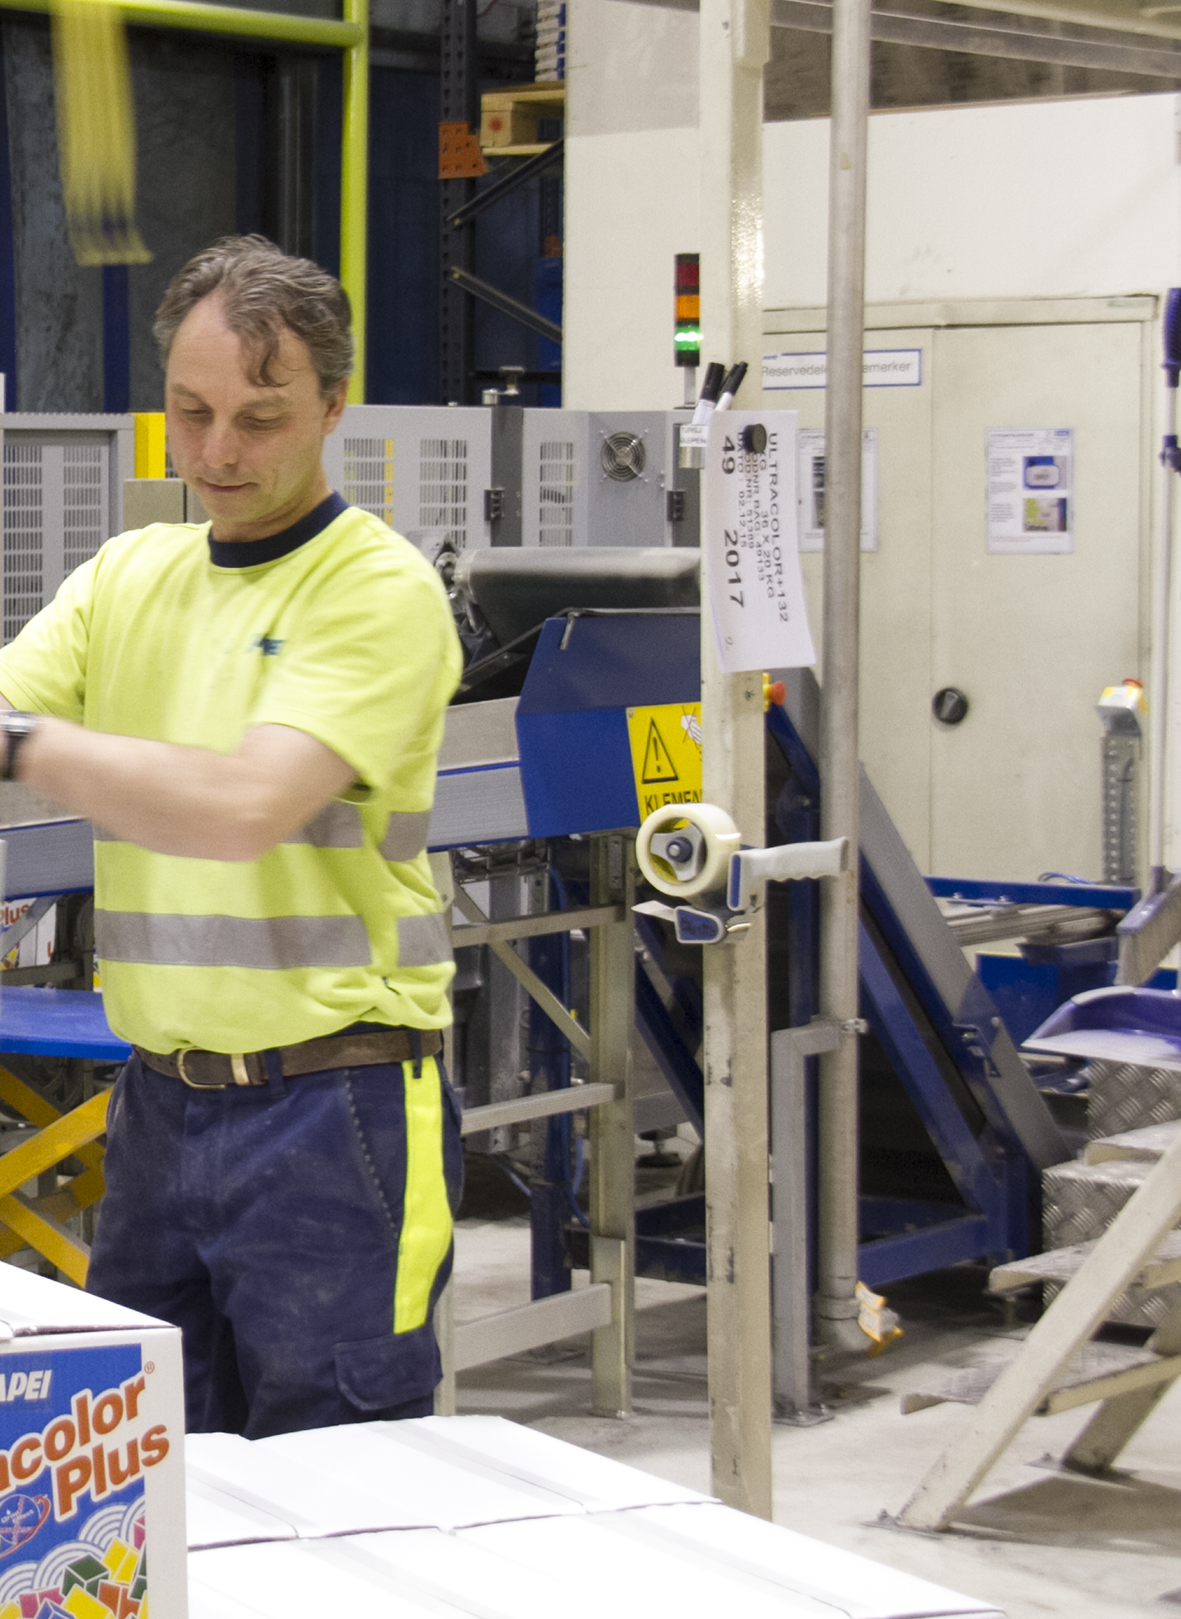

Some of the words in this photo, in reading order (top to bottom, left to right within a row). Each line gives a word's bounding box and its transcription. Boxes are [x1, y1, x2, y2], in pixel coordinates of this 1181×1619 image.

[762, 364, 826, 378] Reservedel
[862, 361, 911, 375] emerker
[722, 435, 735, 475] 49
[724, 529, 745, 608] 2017
[766, 574, 775, 598] KG
[54, 1424, 170, 1518] Plus
